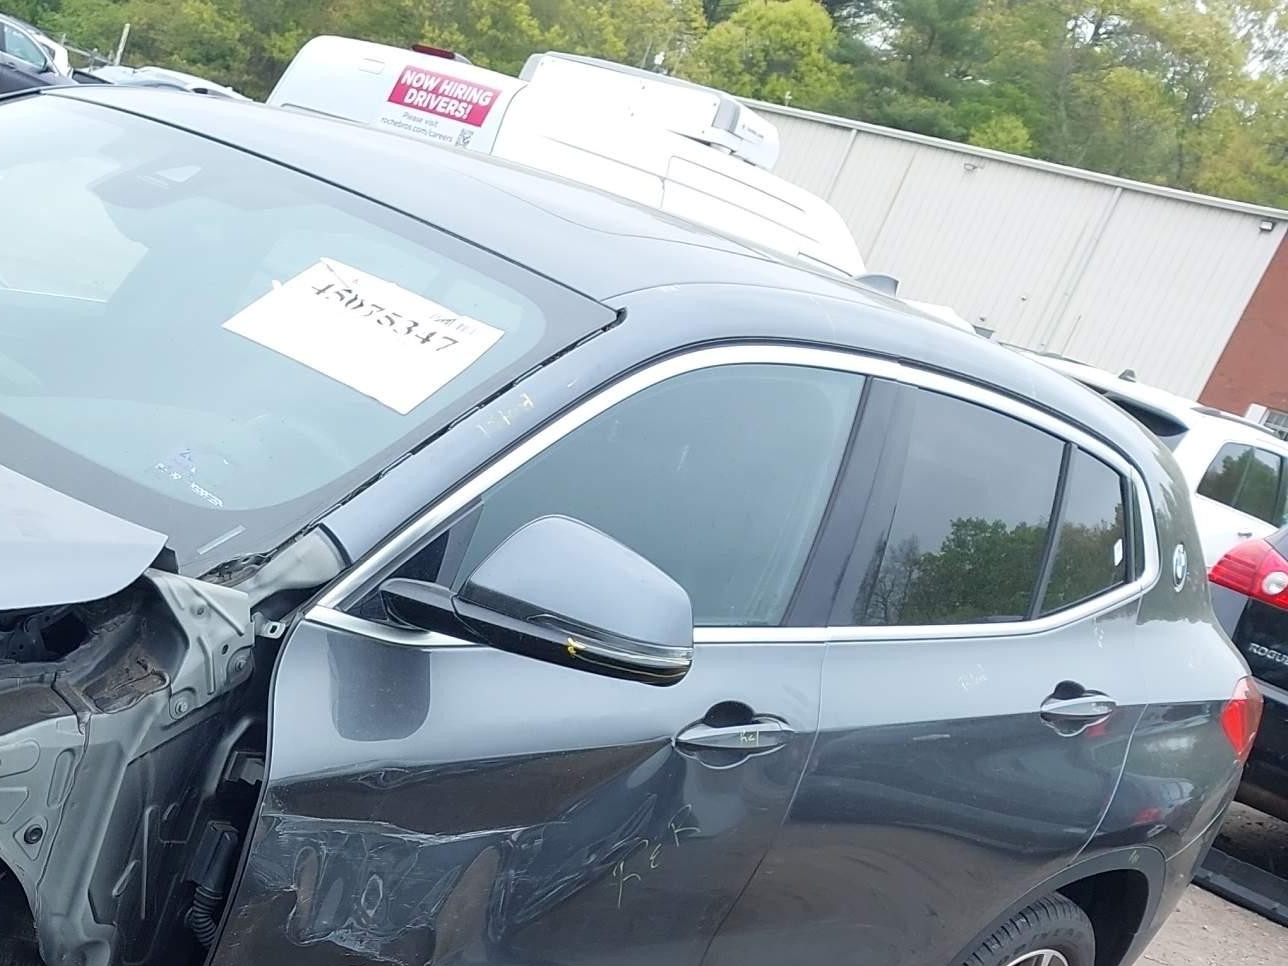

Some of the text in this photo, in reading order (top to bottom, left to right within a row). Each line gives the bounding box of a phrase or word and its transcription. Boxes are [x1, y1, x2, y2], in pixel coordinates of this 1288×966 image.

[401, 70, 494, 107] NOW HIRING
[403, 88, 473, 120] DRIVERS!
[312, 284, 459, 351] 45075347
